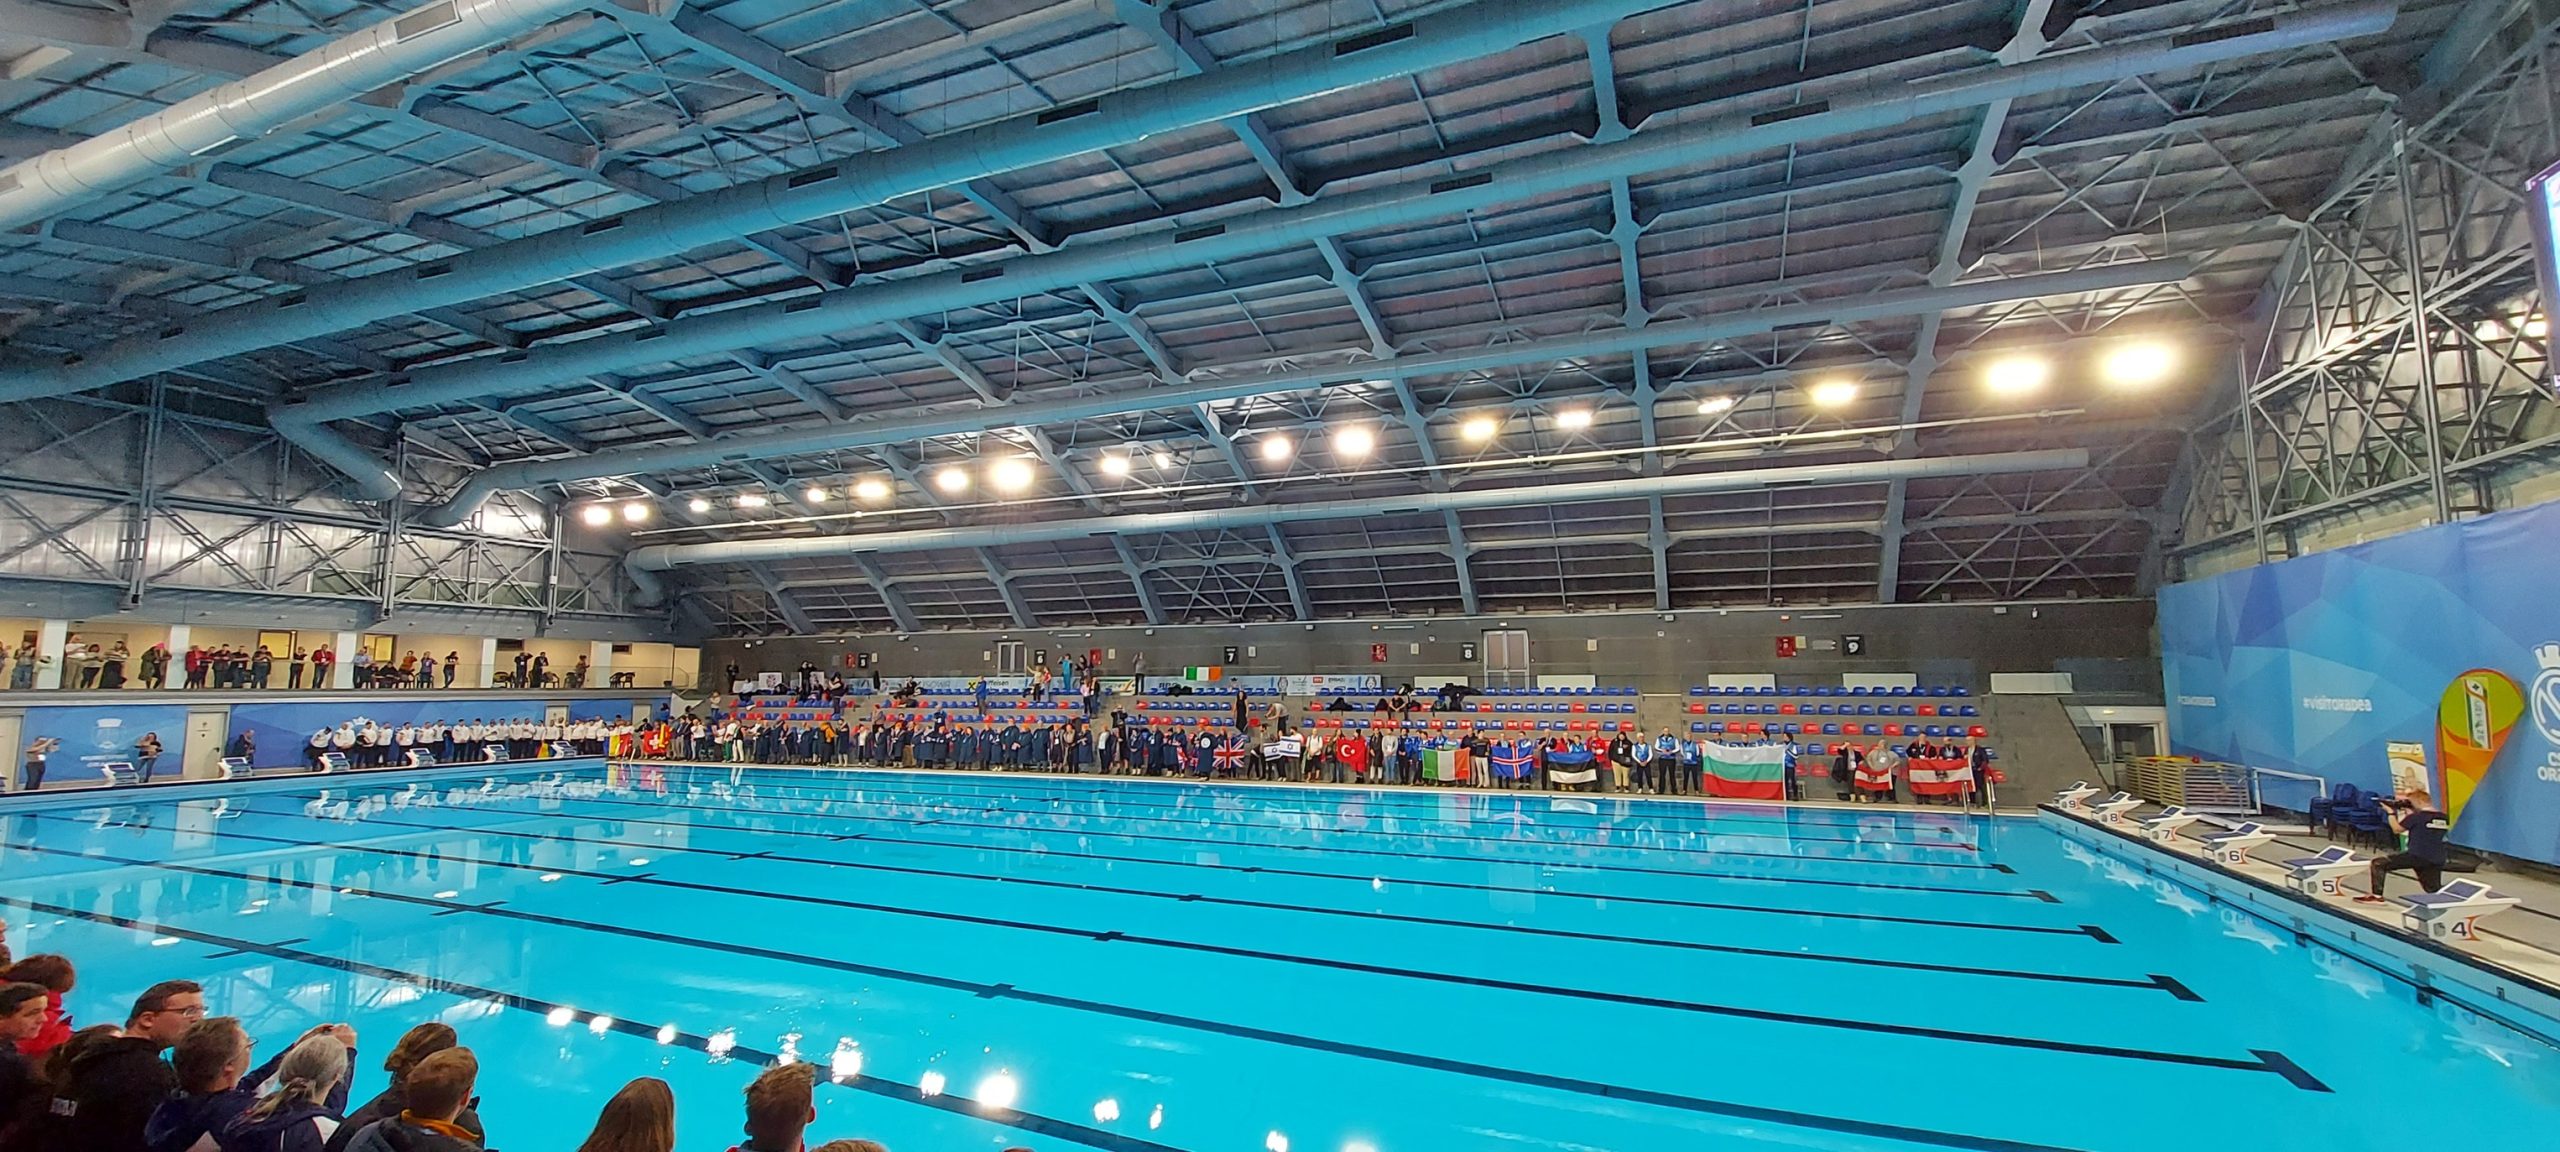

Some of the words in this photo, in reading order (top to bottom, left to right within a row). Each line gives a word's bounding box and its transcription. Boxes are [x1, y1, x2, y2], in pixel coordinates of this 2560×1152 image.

[2162, 829, 2170, 839] 7
[2229, 850, 2240, 862] 6
[2322, 880, 2335, 893] 5
[2451, 921, 2467, 937] 4
